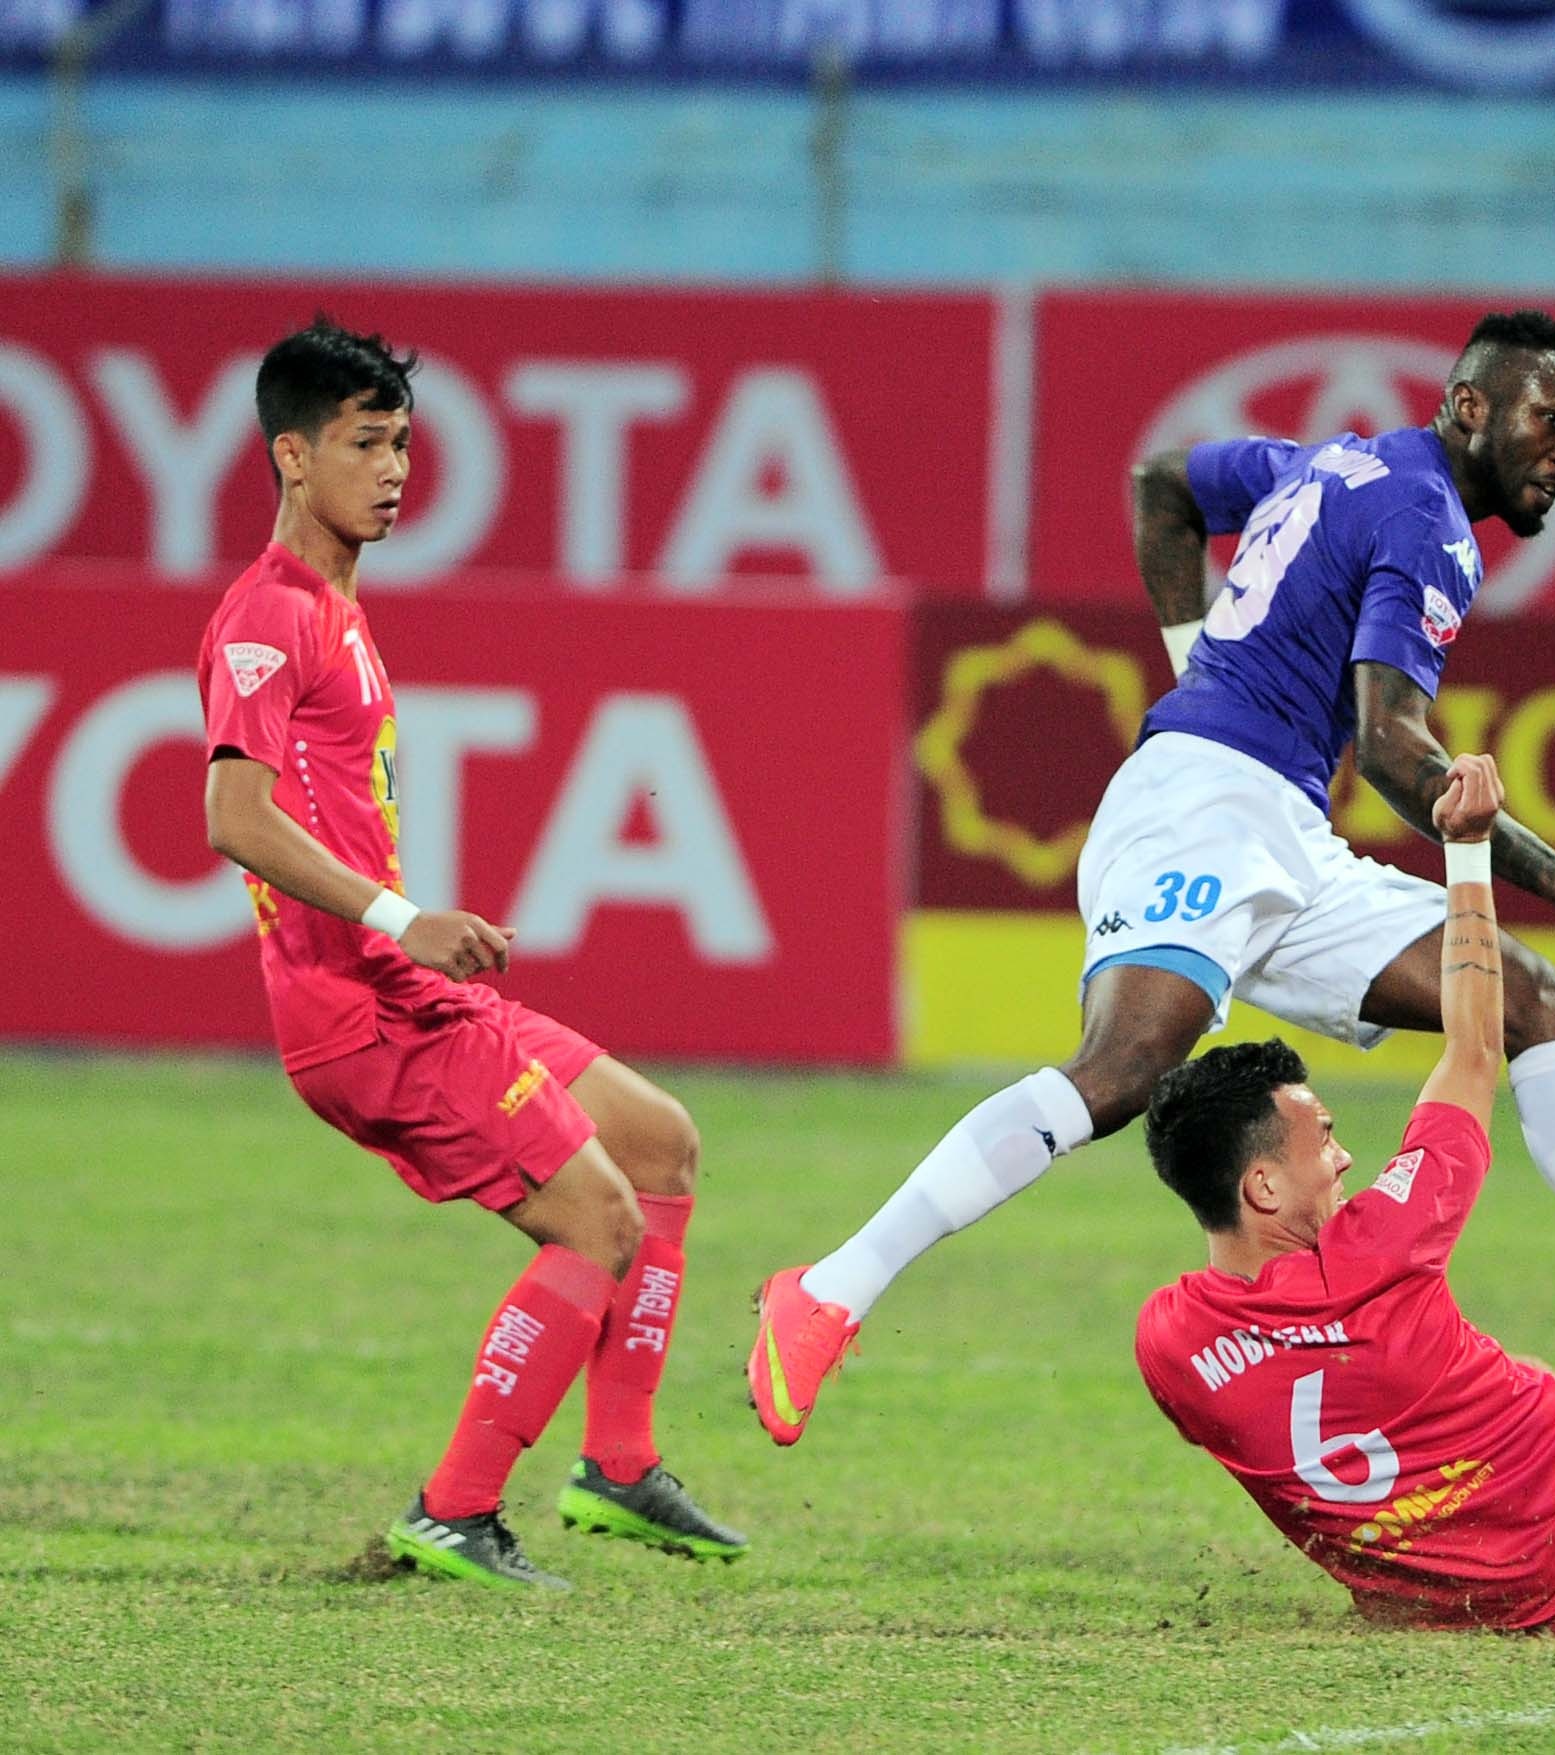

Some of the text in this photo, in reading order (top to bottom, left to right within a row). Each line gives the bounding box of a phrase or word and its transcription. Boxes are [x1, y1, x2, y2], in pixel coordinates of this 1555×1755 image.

[1144, 871, 1222, 922] 39
[474, 1303, 545, 1396] HAGL FC
[625, 1264, 679, 1353] HAGL FC
[1290, 1368, 1400, 1503] 6
